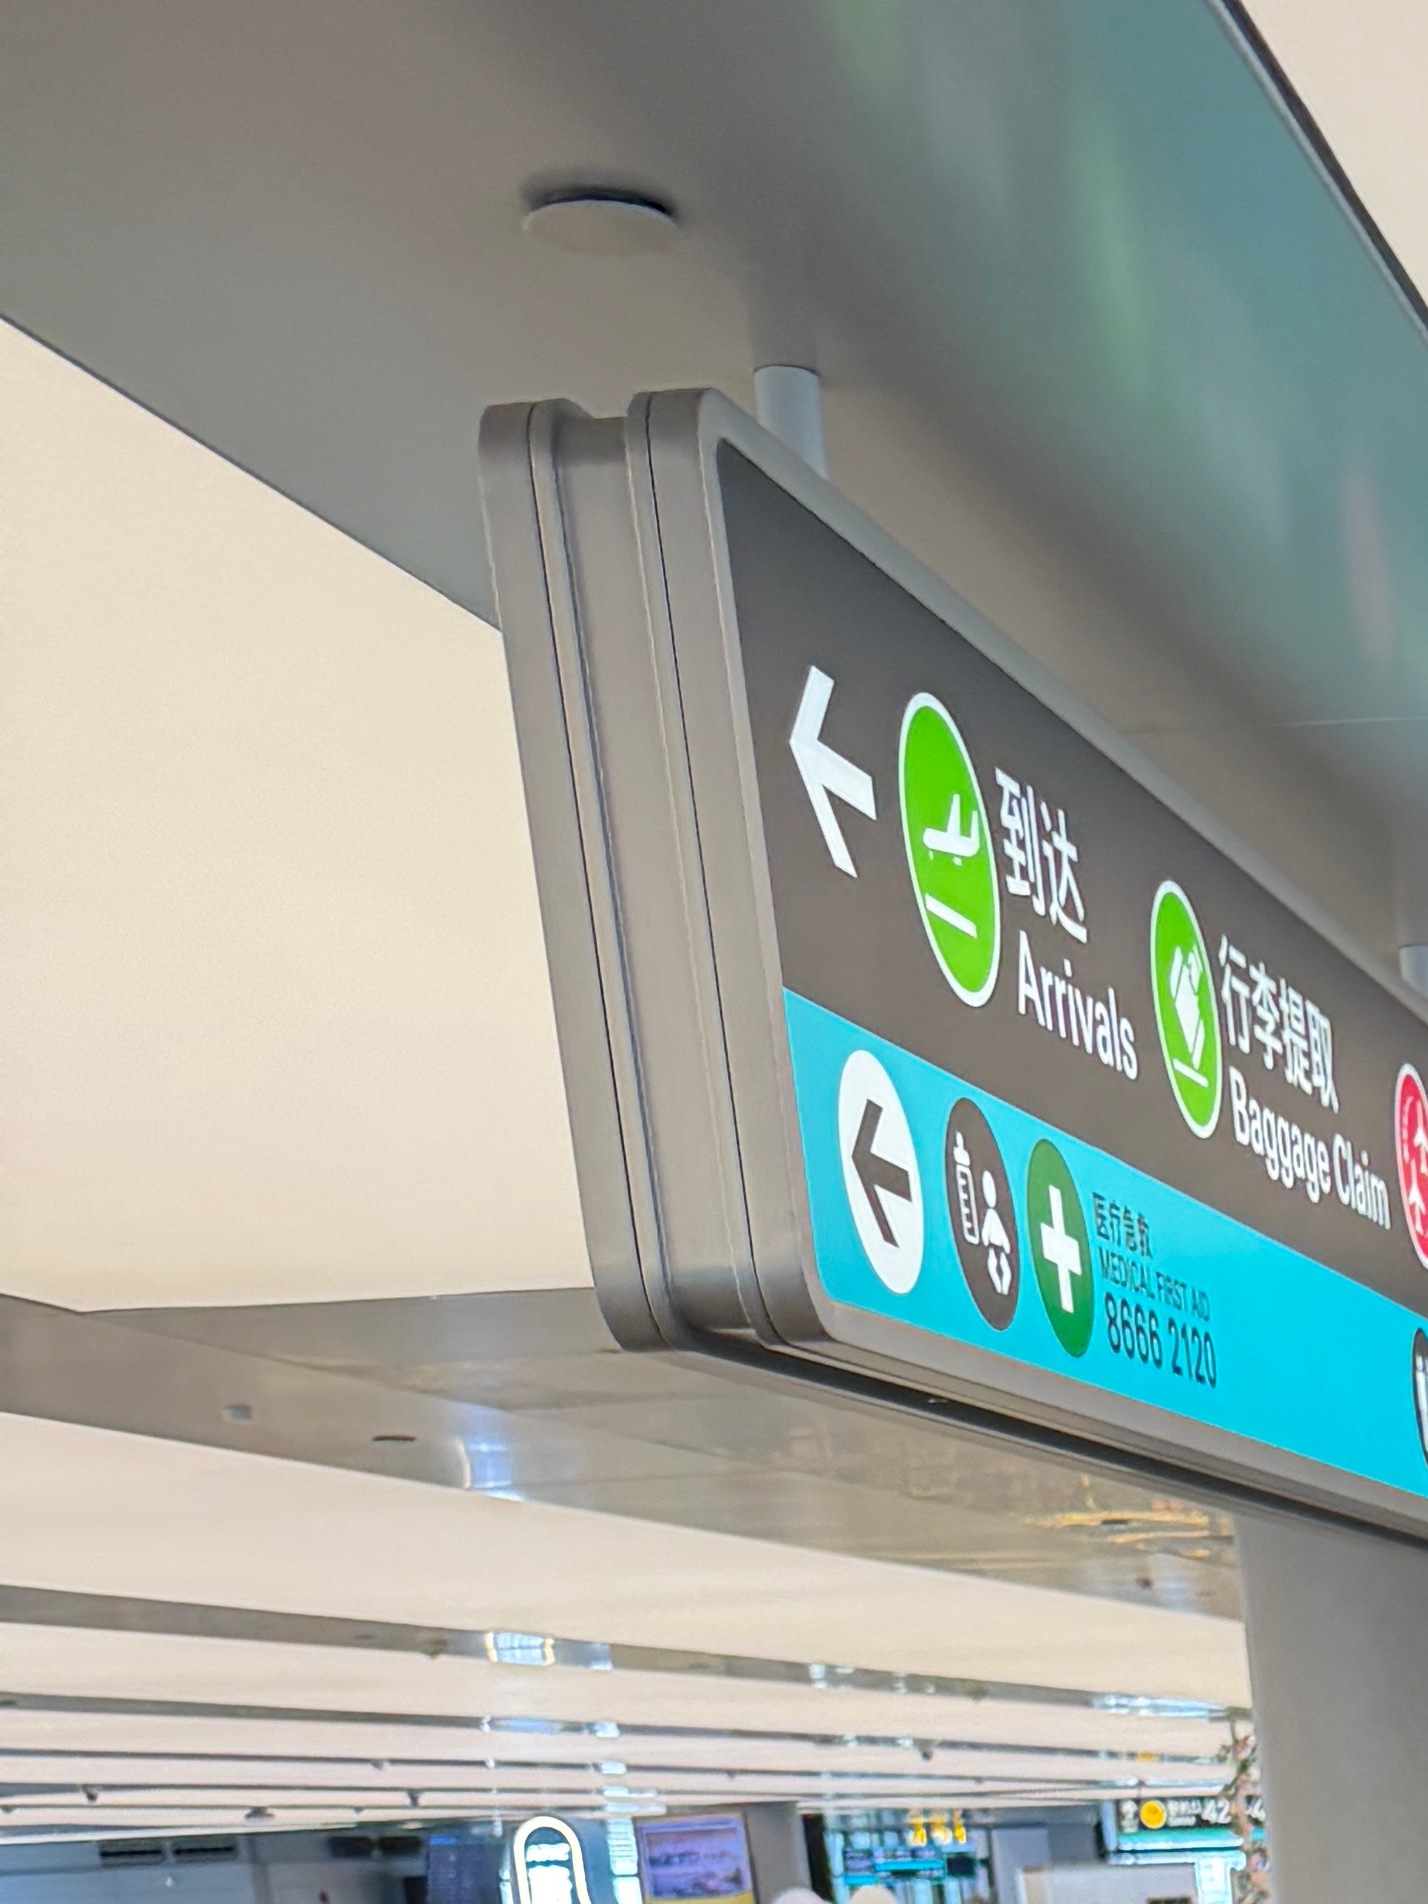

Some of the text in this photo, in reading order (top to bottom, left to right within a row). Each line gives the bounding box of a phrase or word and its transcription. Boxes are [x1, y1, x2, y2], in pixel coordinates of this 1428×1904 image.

[995, 766, 1088, 943] 到达
[1018, 929, 1138, 1080] Arrivals
[1219, 934, 1339, 1114] 行李提取
[1229, 1065, 1391, 1230] Baggage Claim
[1092, 1191, 1154, 1259] 医疗急救
[1098, 1245, 1211, 1323] MEDICAL FIRST AID
[1104, 1291, 1217, 1389] 8666 2120
